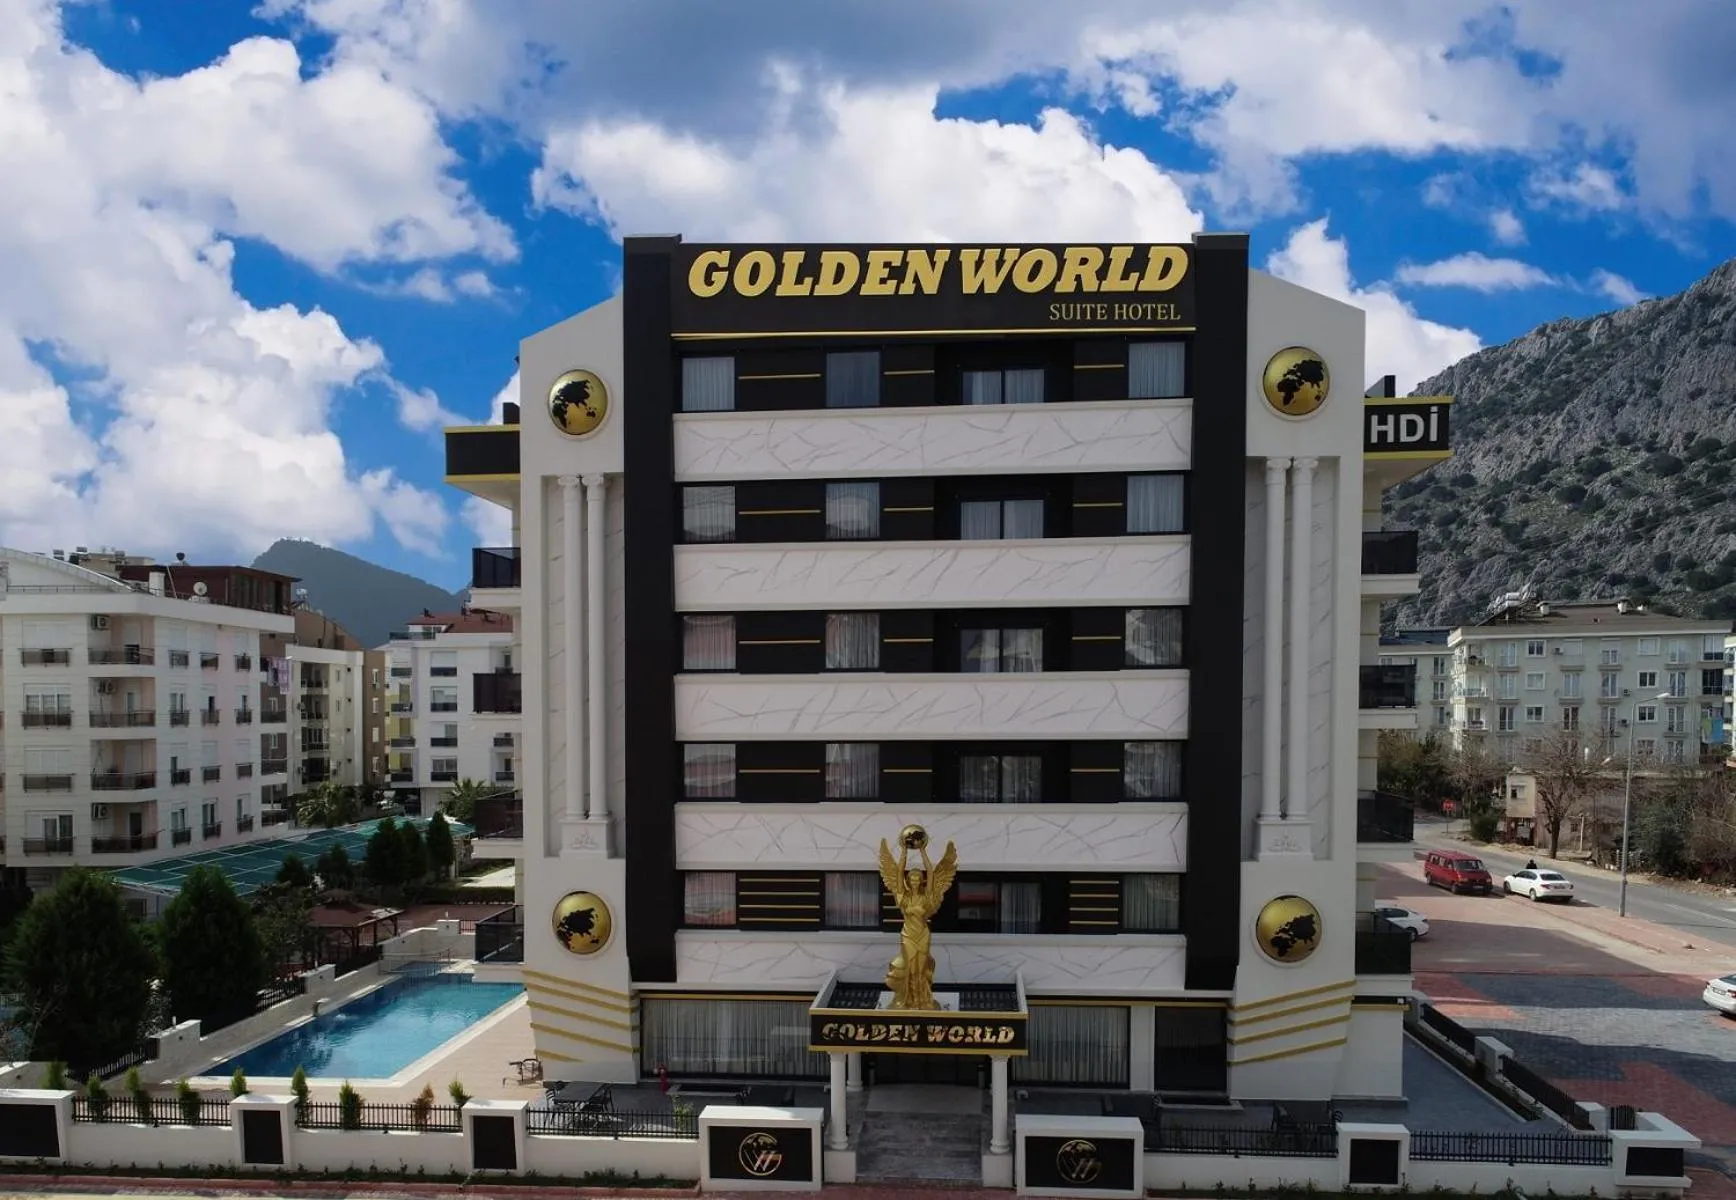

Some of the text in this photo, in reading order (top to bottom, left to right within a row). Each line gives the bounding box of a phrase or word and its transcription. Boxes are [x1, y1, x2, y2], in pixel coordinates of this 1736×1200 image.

[687, 245, 1189, 299] GOLDEN WORLD
[1049, 303, 1181, 321] SUITE HOTEL
[821, 1022, 1016, 1044] GOLDEN WORLD
